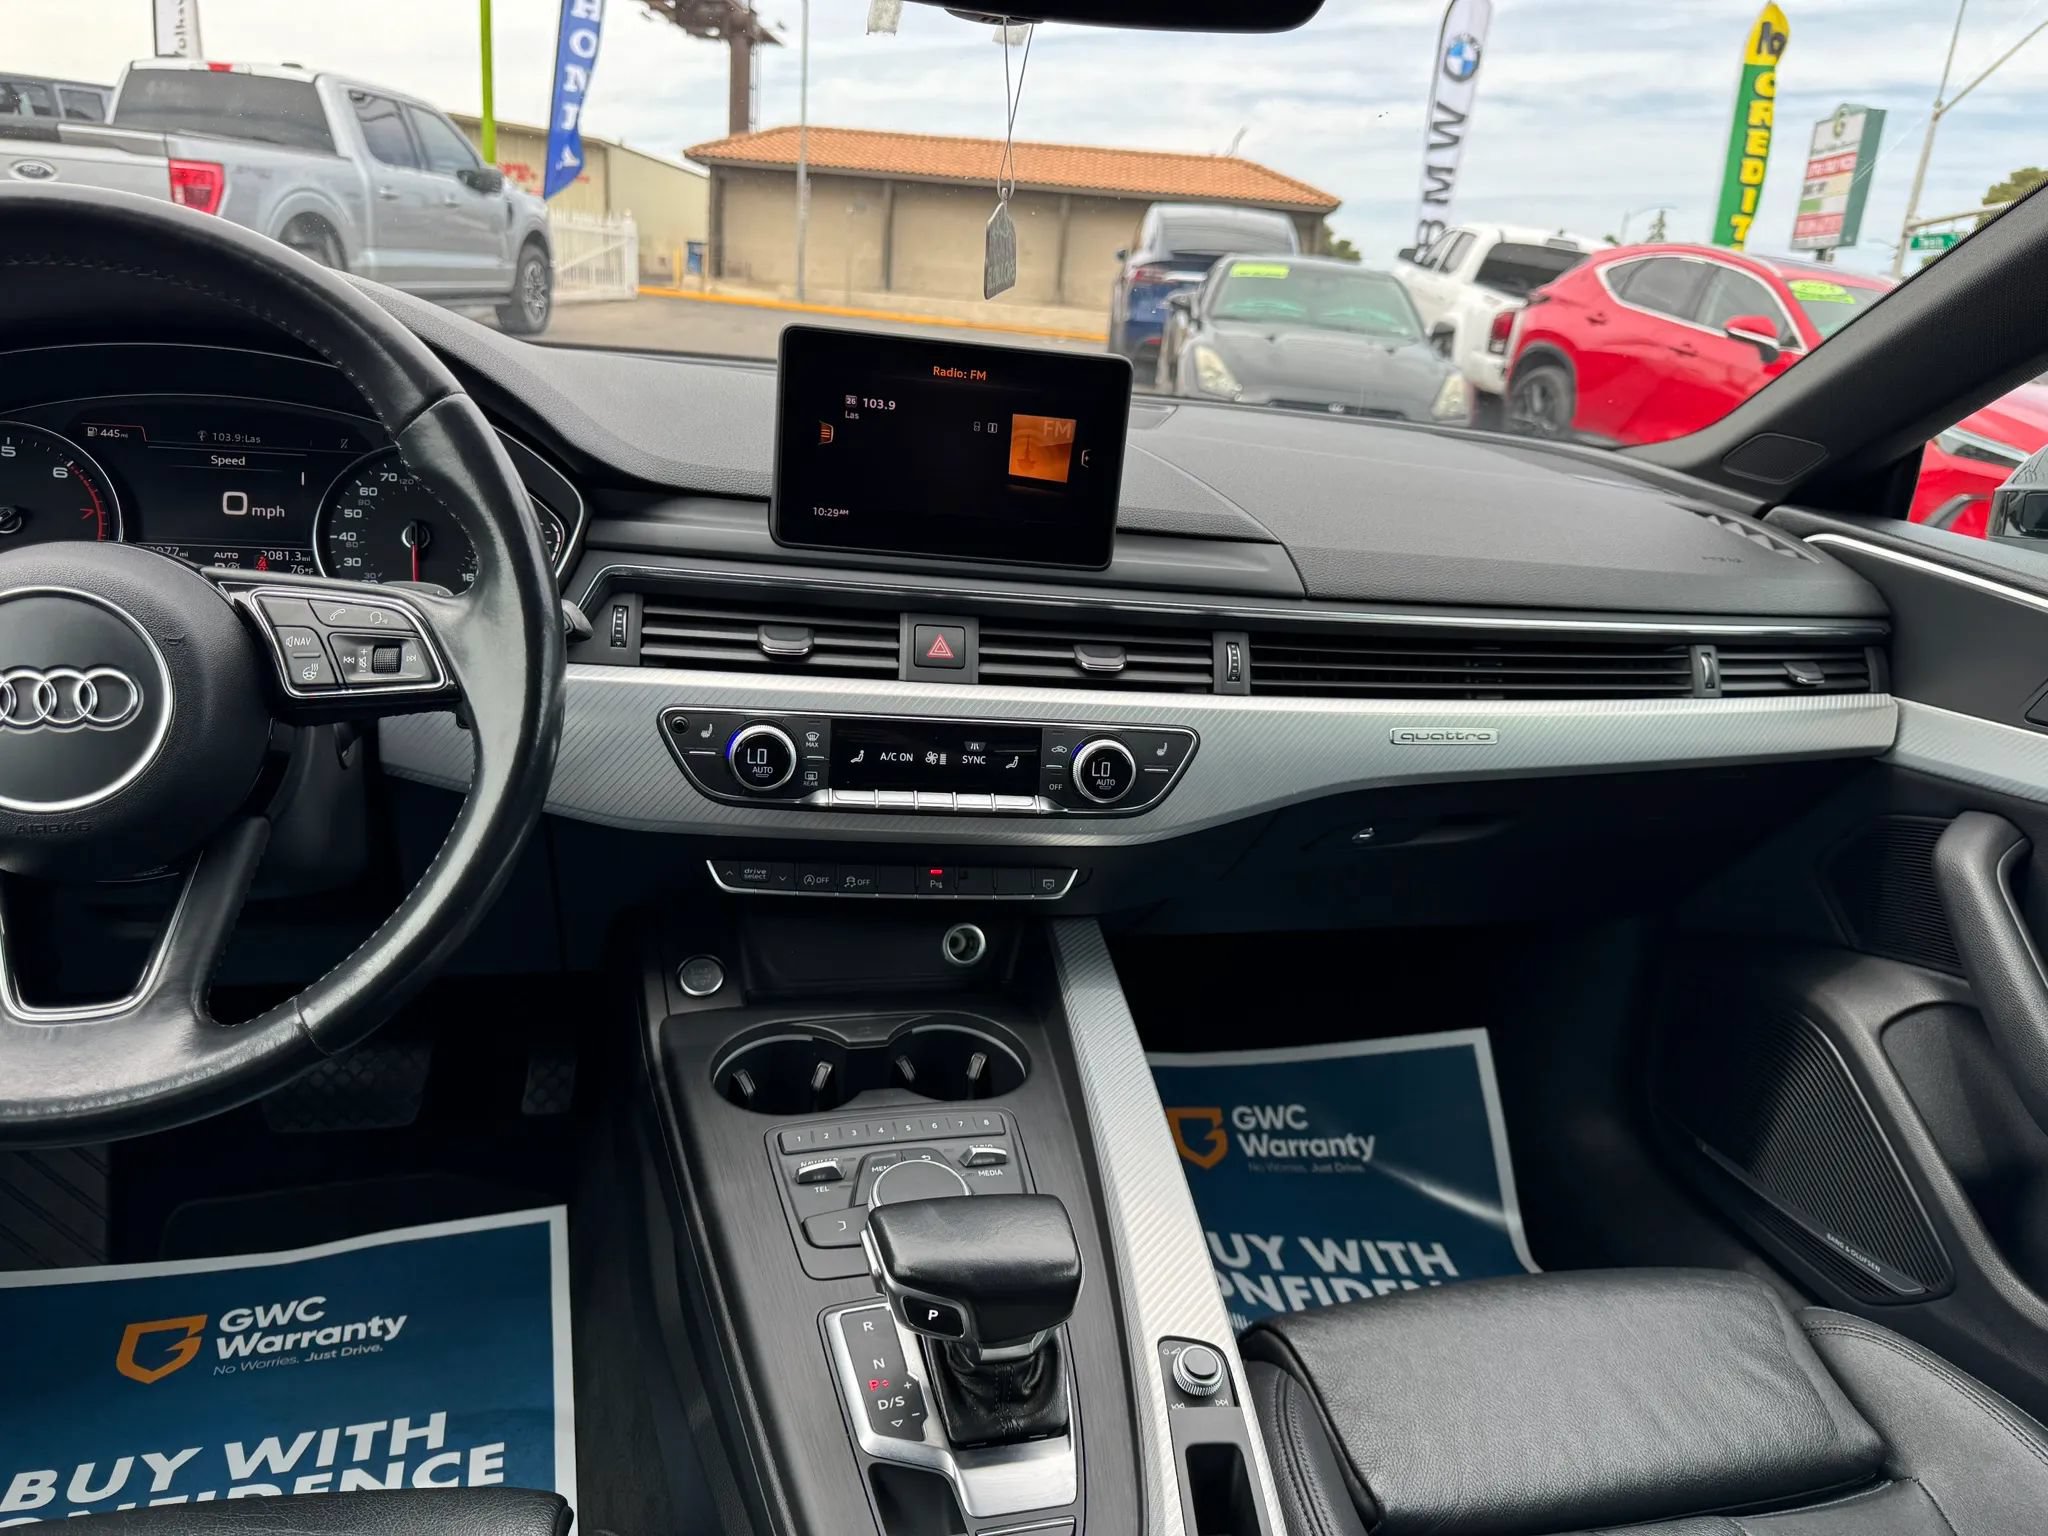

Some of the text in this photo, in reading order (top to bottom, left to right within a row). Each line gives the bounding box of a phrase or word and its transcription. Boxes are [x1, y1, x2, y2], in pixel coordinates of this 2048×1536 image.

[1731, 71, 1776, 242] CREDIT
[1416, 100, 1467, 248] BMW
[933, 366, 987, 381] Radio: FM
[863, 398, 896, 411] 103.9
[845, 411, 860, 420] Las
[1043, 420, 1073, 439] FM
[1, 445, 16, 458] 5
[211, 454, 246, 466] Speed
[52, 466, 68, 478] 6
[379, 472, 398, 482] 70
[359, 487, 378, 496] 60
[222, 491, 286, 520] 0 mph
[344, 509, 362, 518] 50
[338, 532, 357, 541] 40
[214, 551, 239, 559] AUTO
[343, 557, 362, 567] 30
[293, 636, 311, 646] NAV
[1400, 731, 1491, 742] quattro
[880, 752, 913, 762] A/C ON
[962, 755, 987, 765] SYNC
[752, 766, 774, 774] AUTO
[1049, 783, 1063, 791] OFF
[1096, 778, 1116, 786] AUTO
[858, 878, 871, 886] OFF
[1231, 1104, 1309, 1131] GWC
[1236, 1132, 1376, 1162] Warranty
[978, 1168, 1003, 1177] MEDIA
[814, 1185, 830, 1193] TEL
[1299, 1235, 1460, 1277] WITH
[219, 1295, 327, 1333] GWC
[927, 1309, 939, 1321] P
[862, 1321, 875, 1333] R
[216, 1314, 408, 1360] Warranty
[213, 1344, 384, 1376] No Worries. Just Drive.
[872, 1357, 885, 1370] N
[868, 1380, 879, 1392] P
[878, 1396, 905, 1411] D/S
[0, 1447, 204, 1513] BUY
[224, 1411, 447, 1481] WITH
